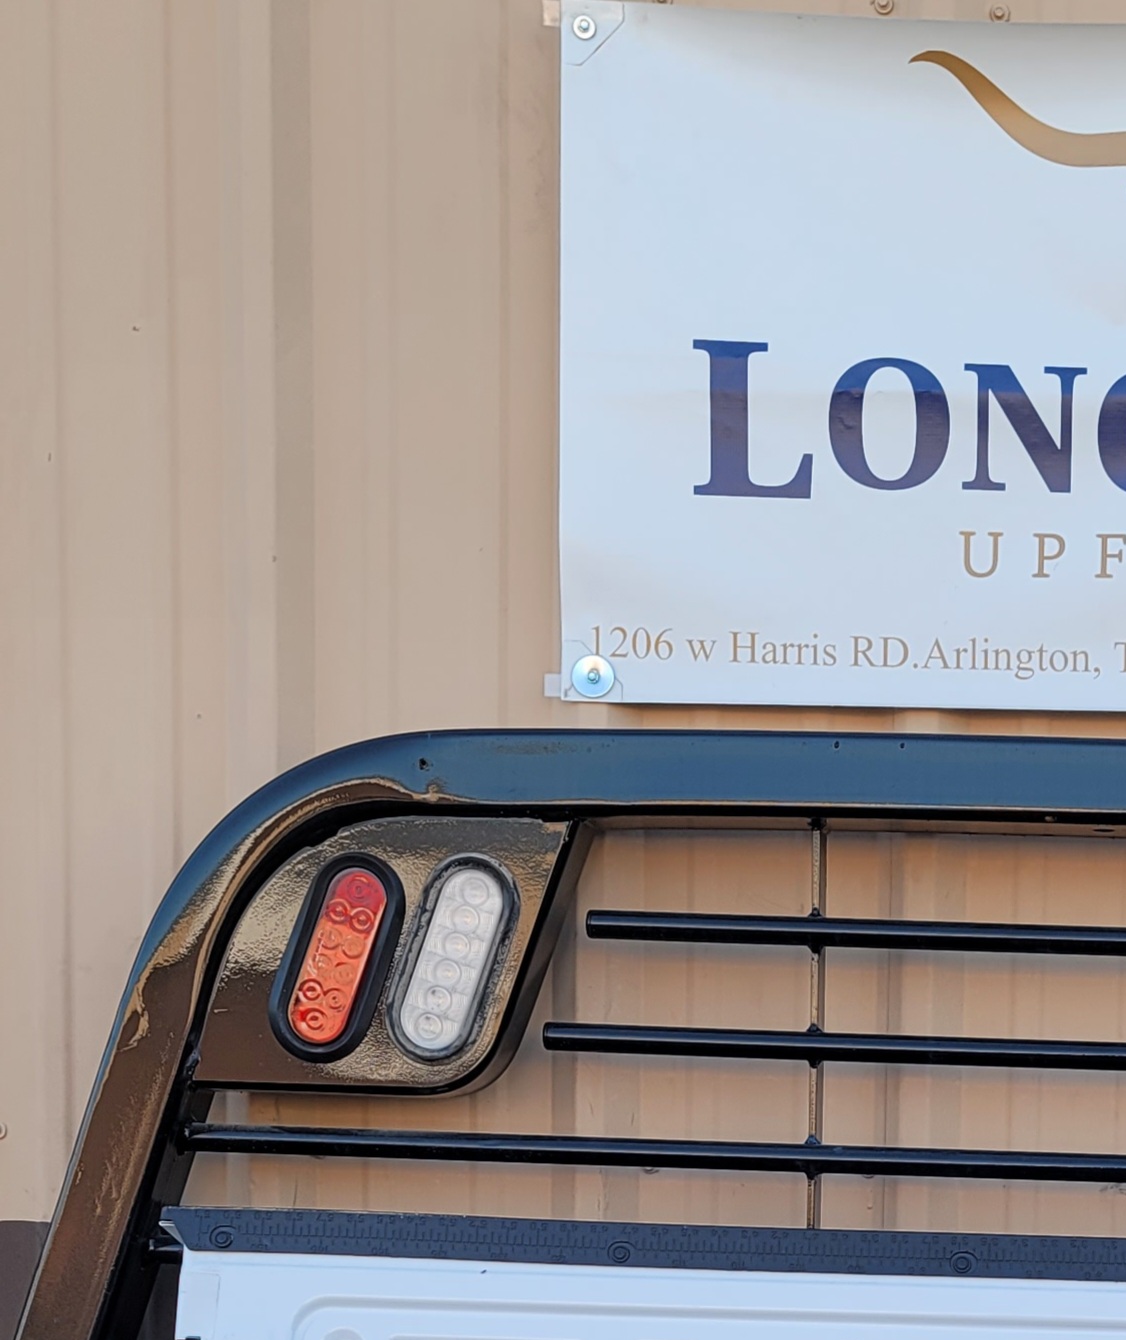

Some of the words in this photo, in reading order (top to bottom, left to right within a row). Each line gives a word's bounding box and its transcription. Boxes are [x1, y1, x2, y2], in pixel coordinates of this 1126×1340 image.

[591, 625, 674, 661] 1206
[686, 639, 717, 662] w
[729, 631, 837, 667] Harris
